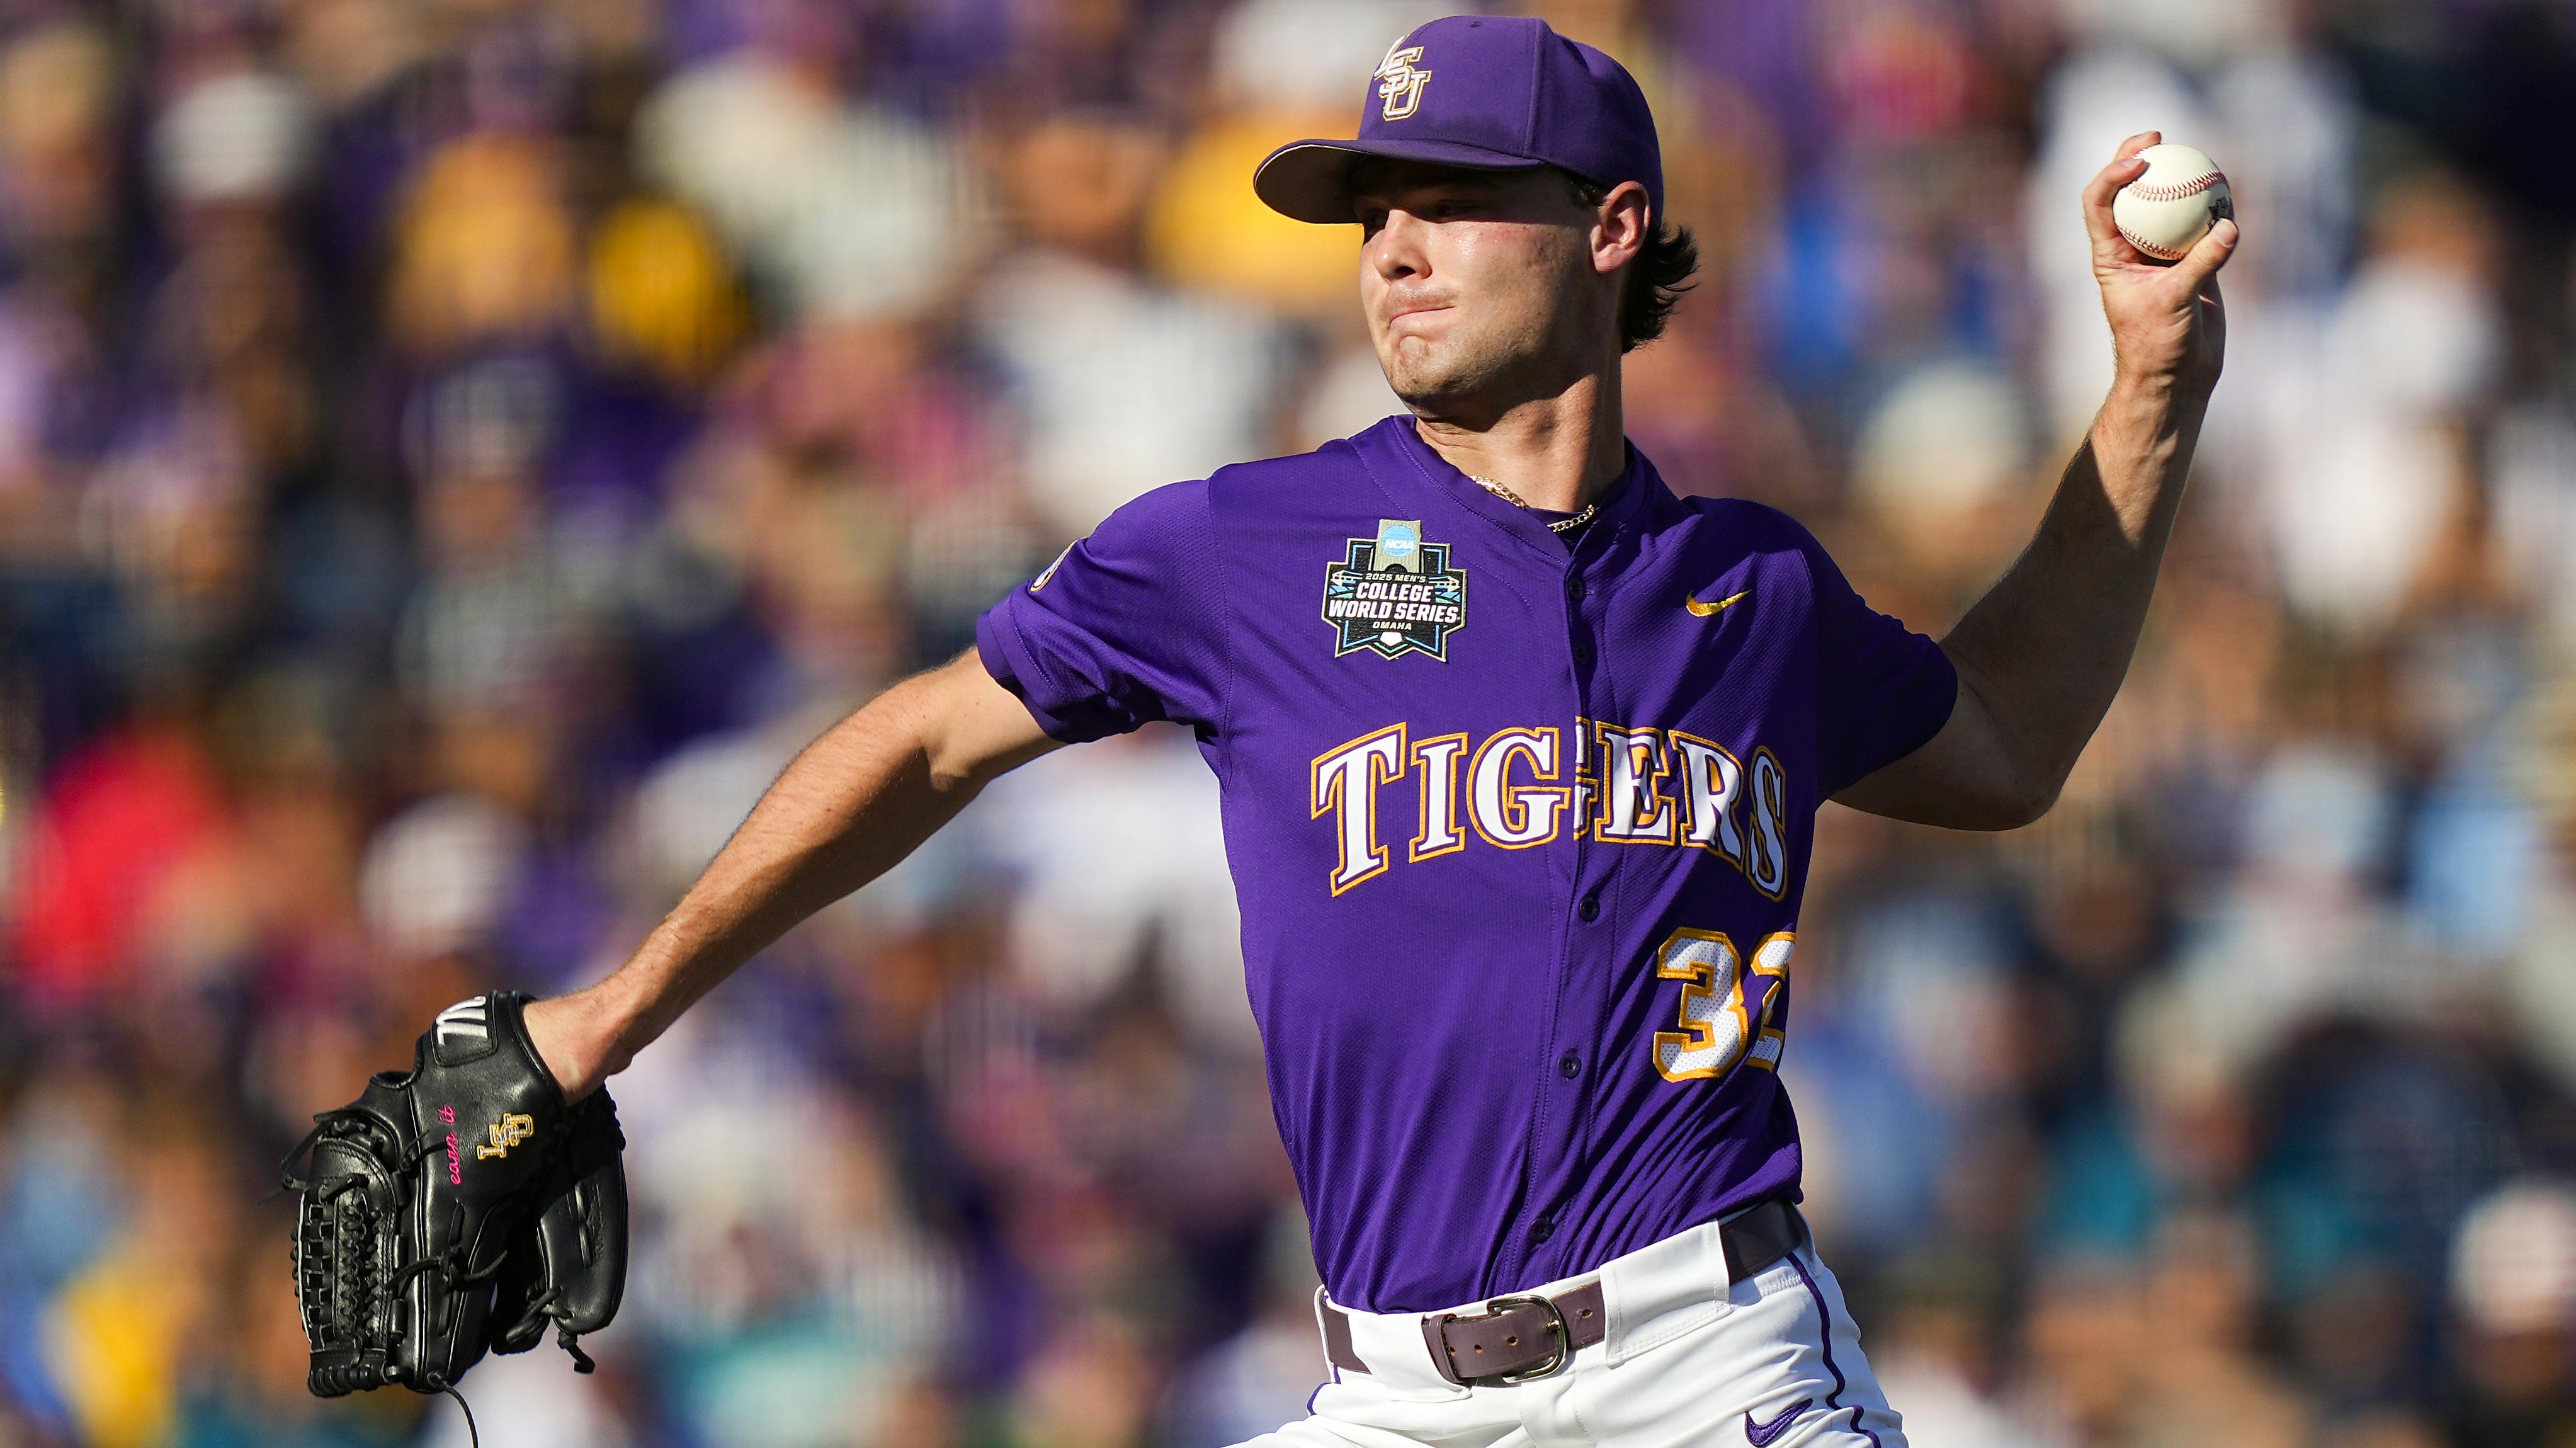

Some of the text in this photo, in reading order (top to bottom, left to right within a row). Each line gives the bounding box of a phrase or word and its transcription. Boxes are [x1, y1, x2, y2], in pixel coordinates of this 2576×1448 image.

[1374, 36, 1432, 121] LSU
[1385, 539, 1415, 549] NCAA
[1356, 582, 1434, 602] COLLEGE
[1365, 573, 1426, 583] 2025 MEN'S
[1329, 600, 1458, 624] WORLD SERIES
[1372, 621, 1412, 630] OMAHA
[1311, 716, 1788, 903] TIGERS
[1652, 926, 1796, 1083] 32
[438, 1104, 461, 1185] earn it
[477, 1113, 534, 1160] LSU
